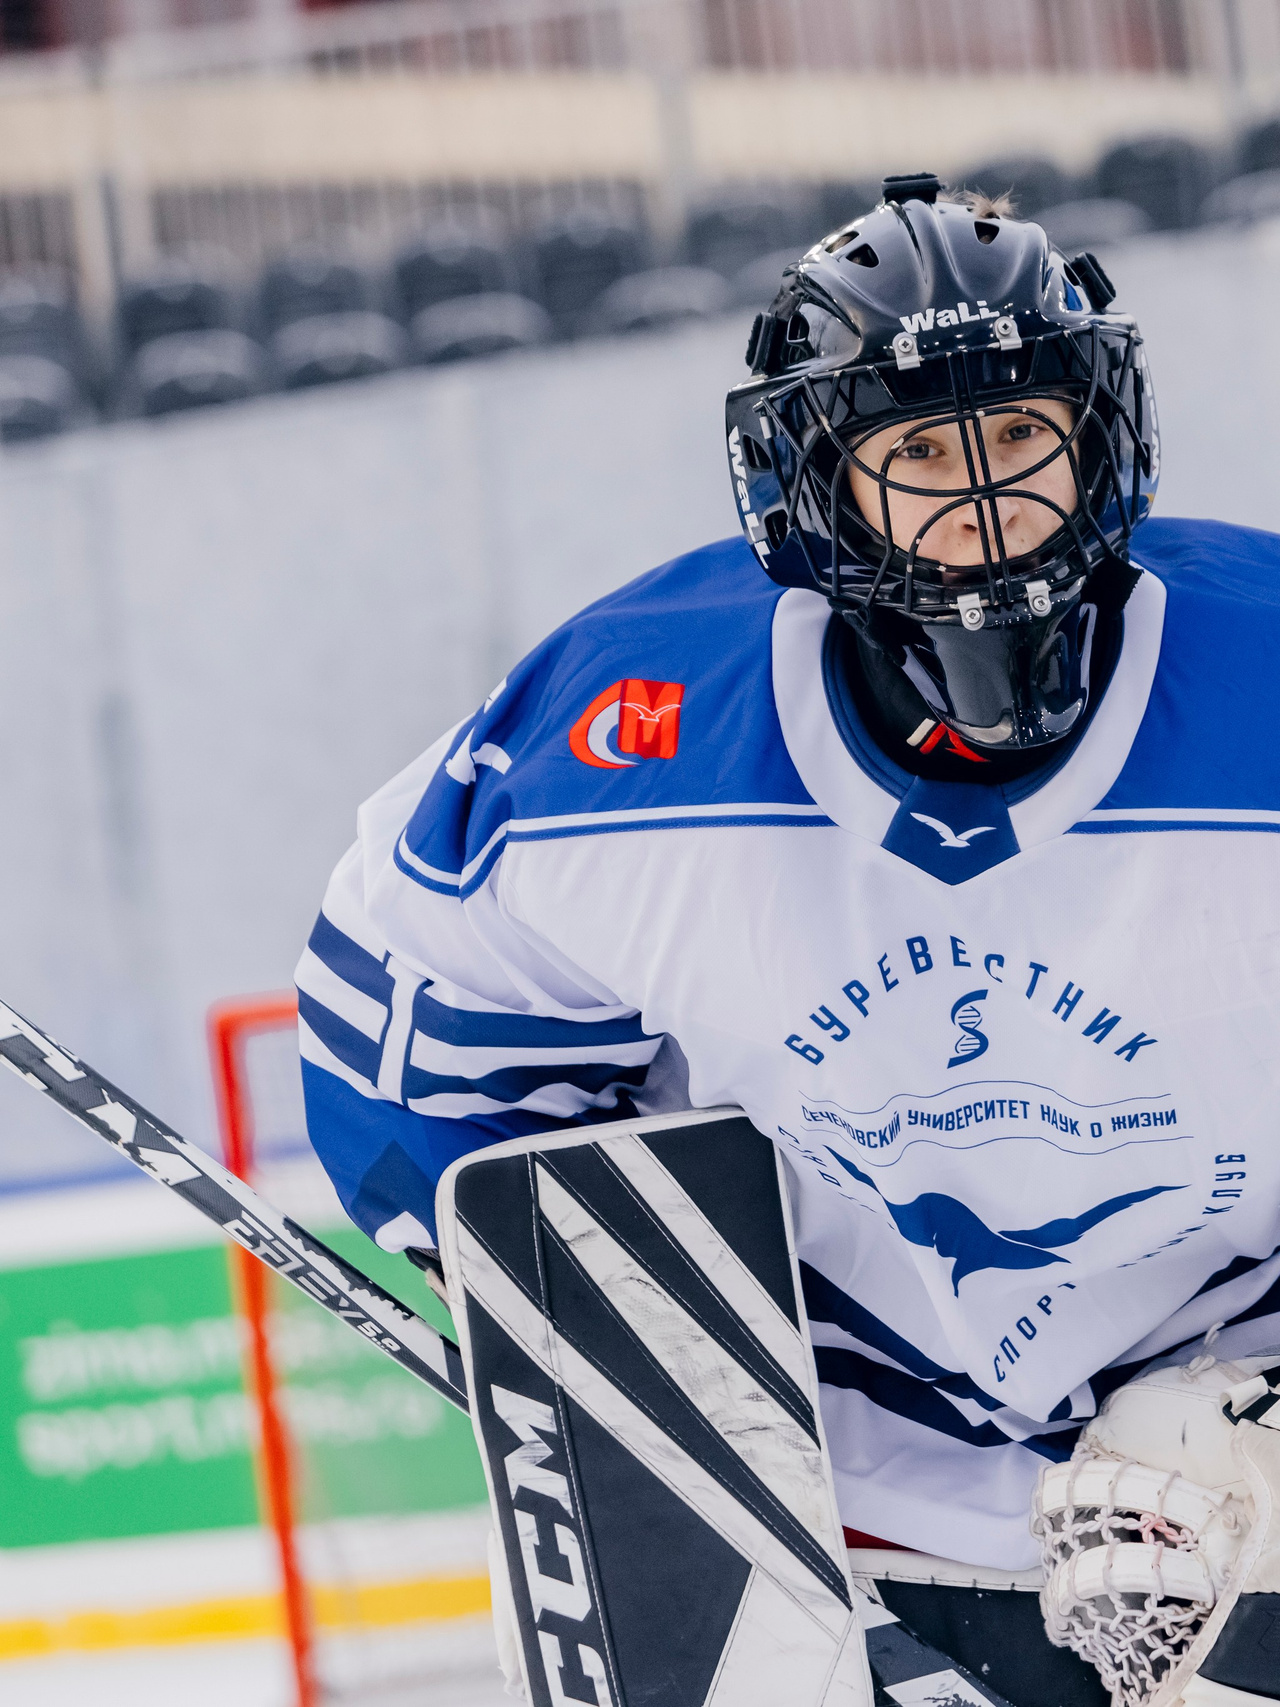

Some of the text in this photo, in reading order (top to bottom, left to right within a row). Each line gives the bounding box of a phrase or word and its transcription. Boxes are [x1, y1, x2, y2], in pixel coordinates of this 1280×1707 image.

[784, 935, 1158, 1066] БУРЕВЕСТНИК
[801, 1100, 1177, 1148] СЕЧЕНОВСКИЙ УНИВЕРСИТЕТ НАУК О ЖИЗНИ
[1202, 1153, 1246, 1215] КЛУБ
